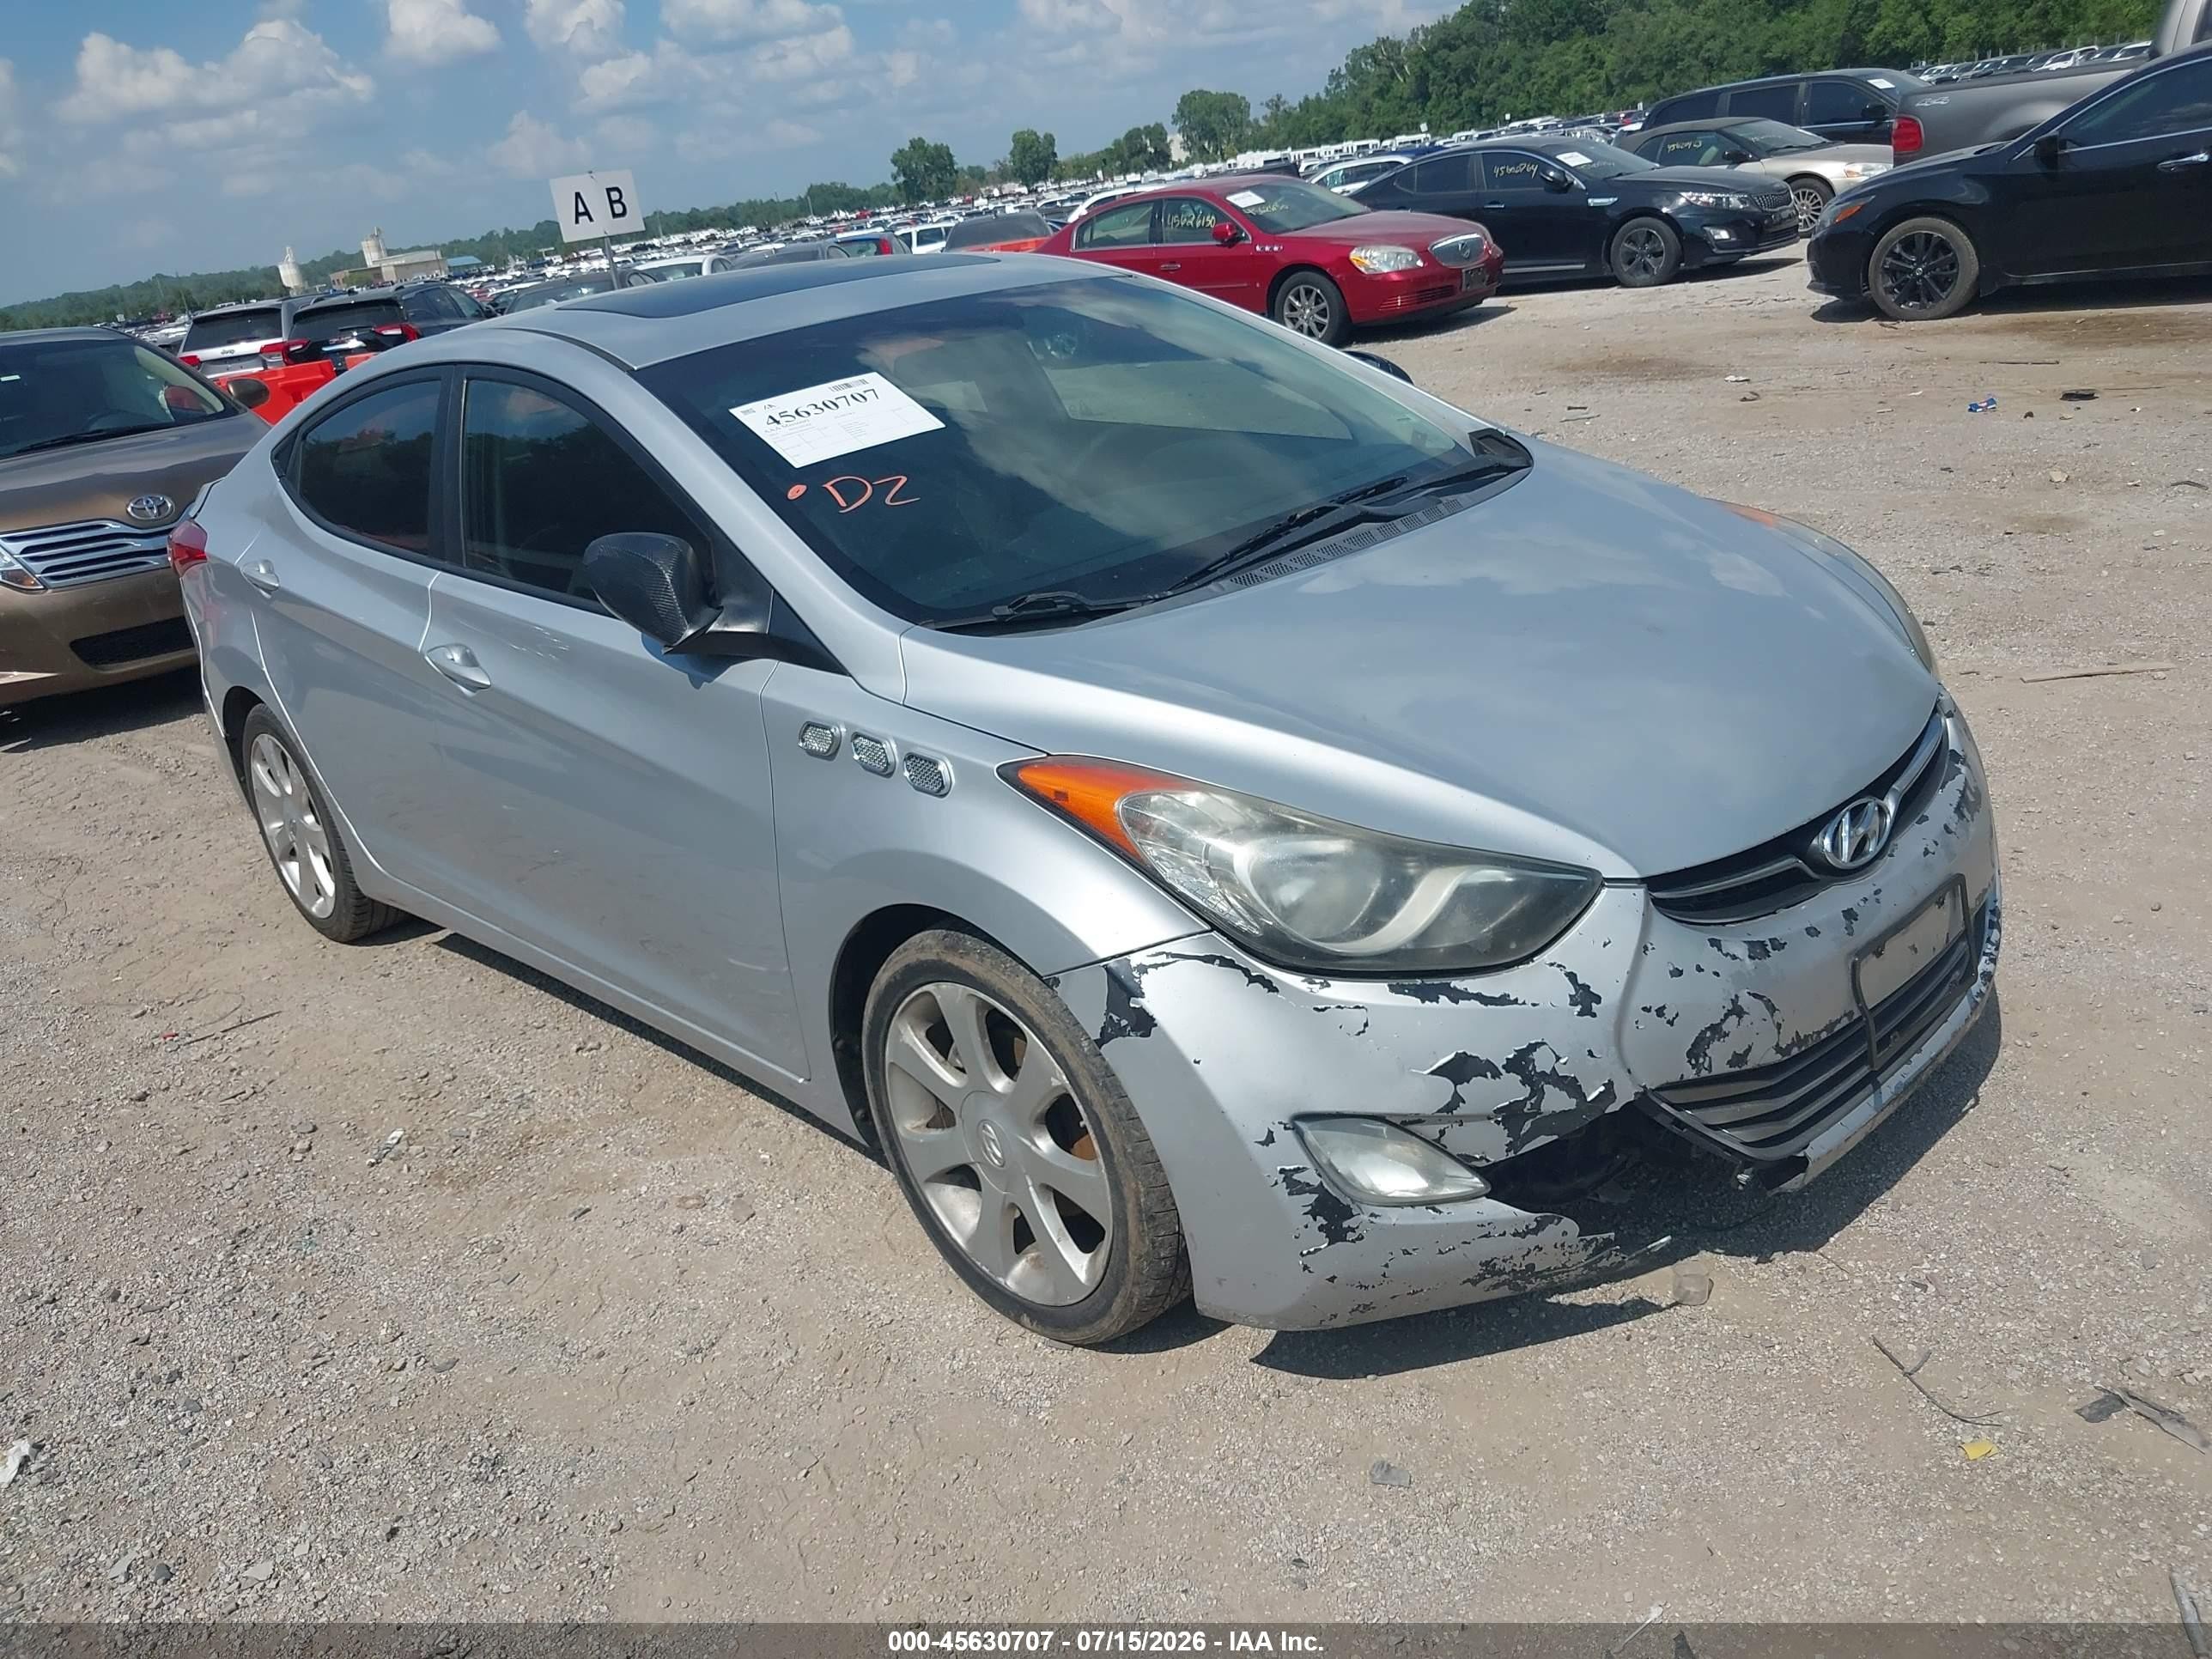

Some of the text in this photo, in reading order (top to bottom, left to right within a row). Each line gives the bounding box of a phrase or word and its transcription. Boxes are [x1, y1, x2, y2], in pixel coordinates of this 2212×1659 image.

[574, 186, 628, 224] A B
[766, 388, 880, 426] 45630707
